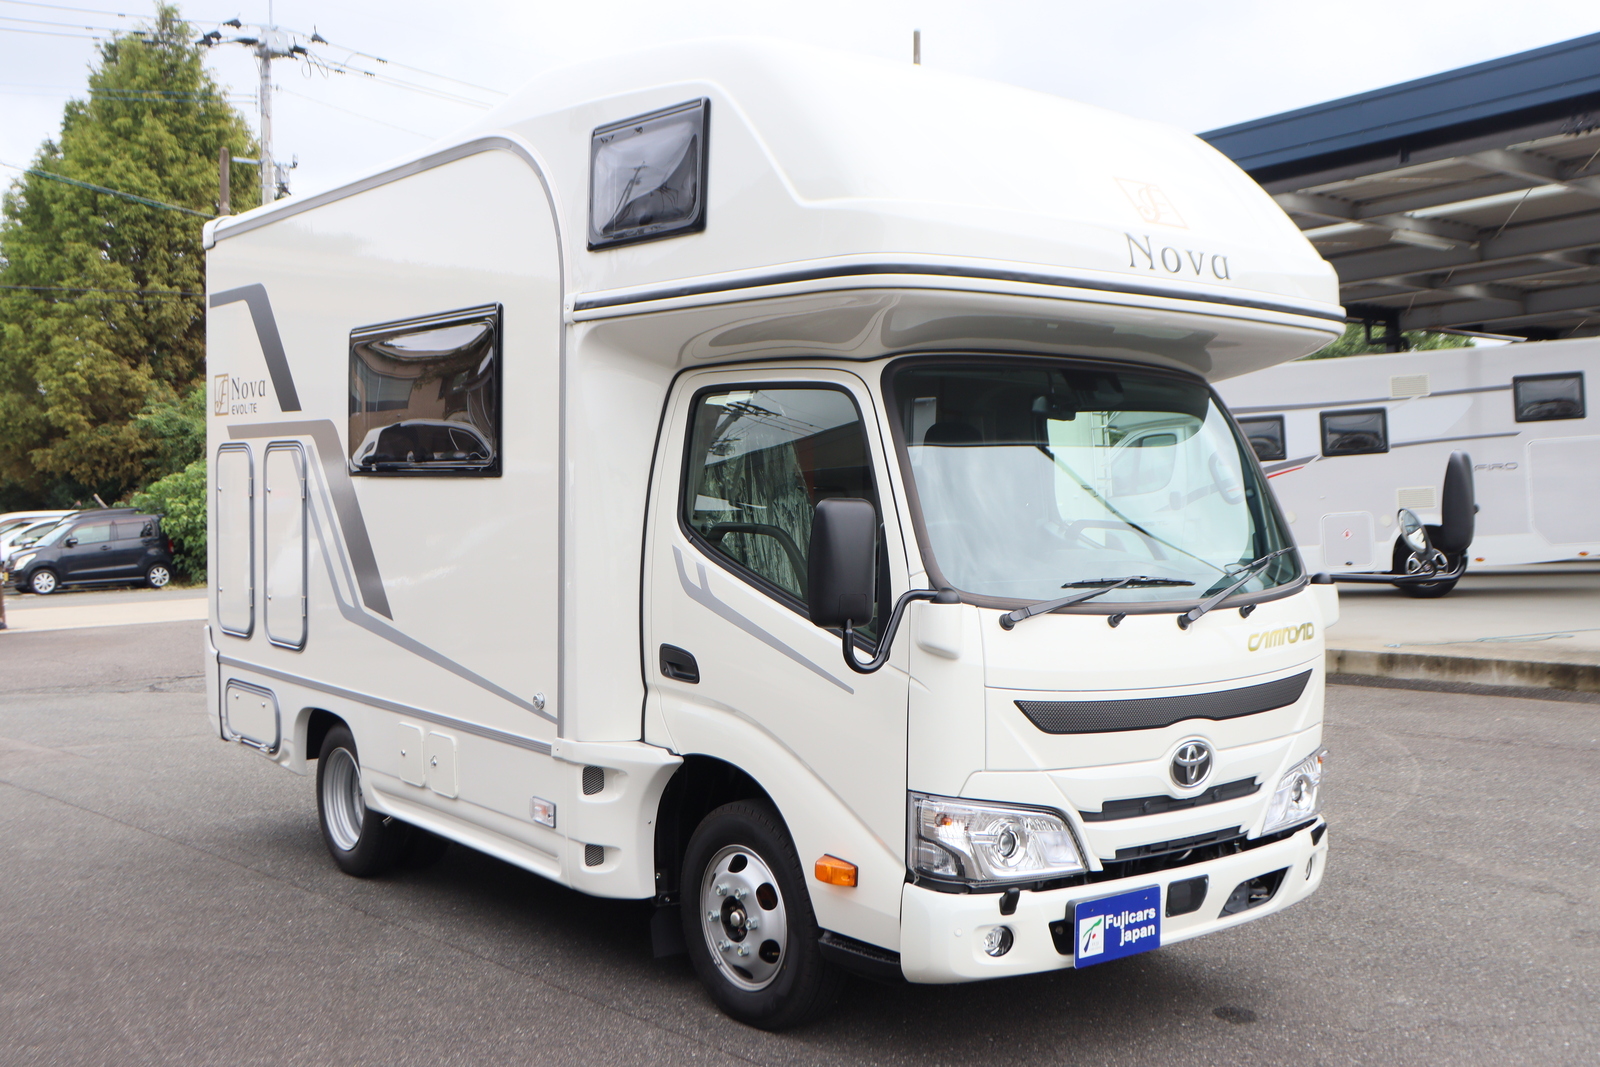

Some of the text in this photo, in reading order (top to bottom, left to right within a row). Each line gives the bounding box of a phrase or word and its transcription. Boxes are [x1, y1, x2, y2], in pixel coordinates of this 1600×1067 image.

[1124, 232, 1231, 280] Nova
[232, 377, 266, 400] Nova
[1474, 462, 1518, 472] FIRO
[1248, 622, 1314, 652] CAMROAD
[1105, 908, 1156, 929] Fujicars
